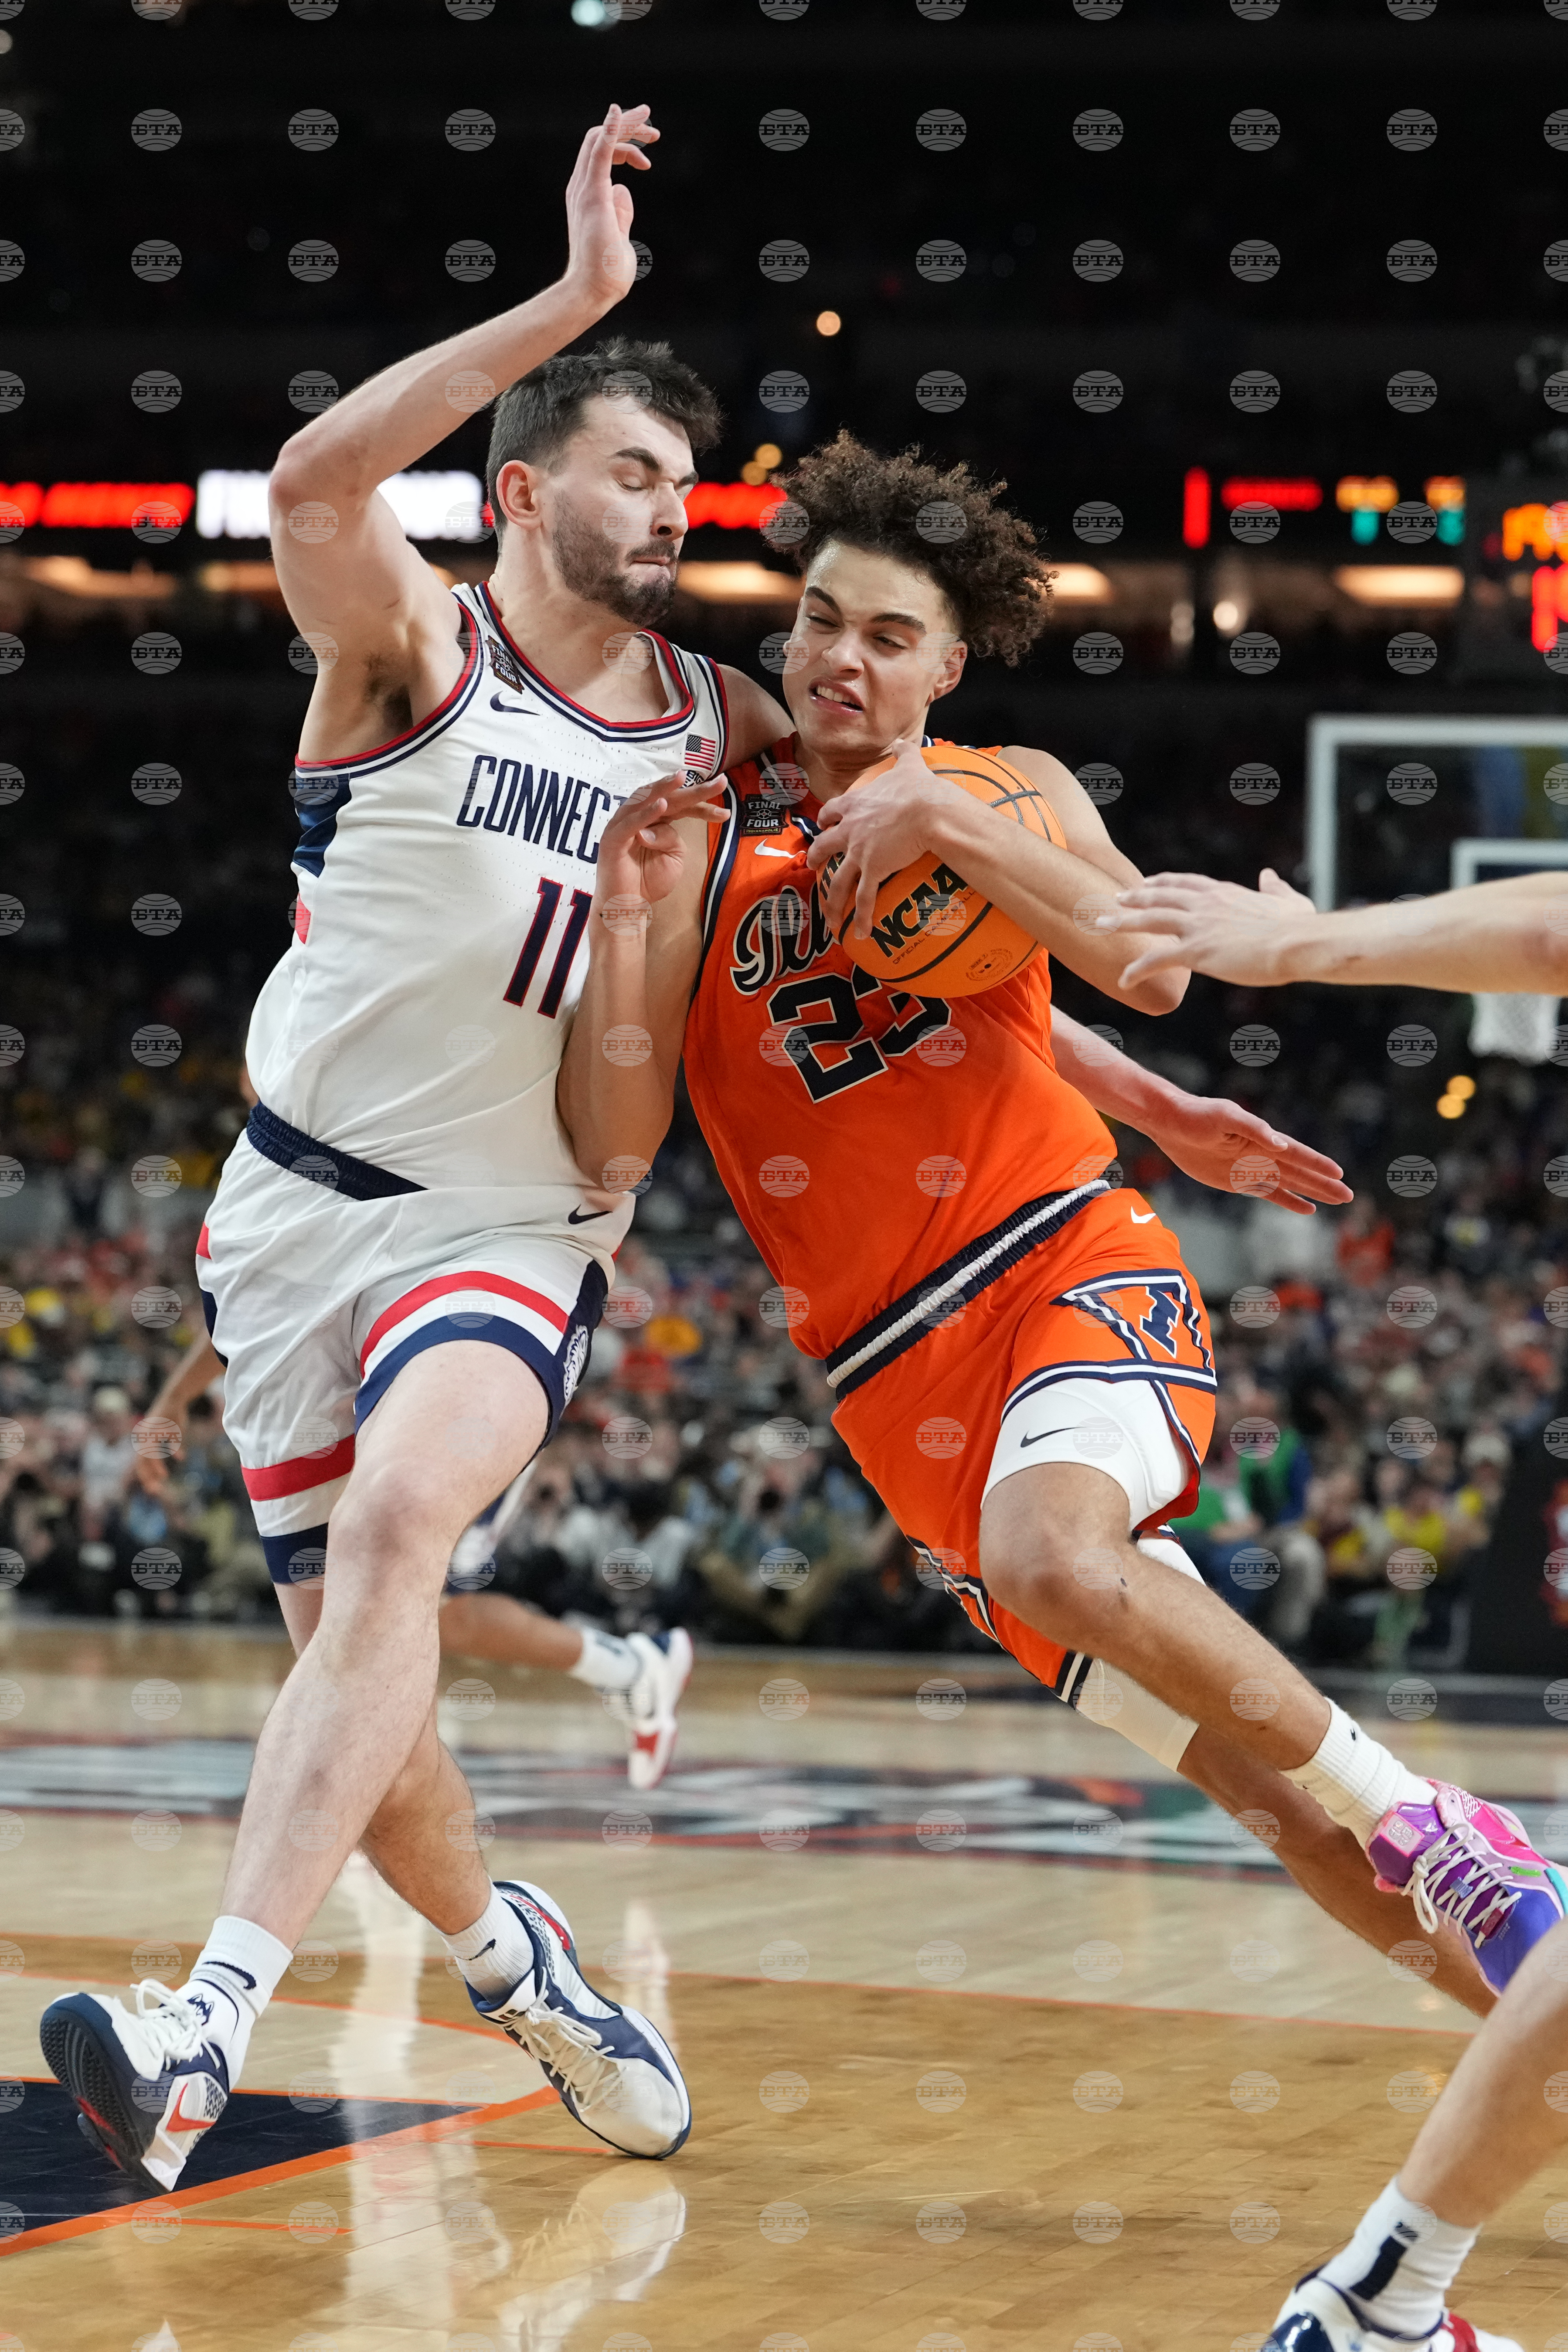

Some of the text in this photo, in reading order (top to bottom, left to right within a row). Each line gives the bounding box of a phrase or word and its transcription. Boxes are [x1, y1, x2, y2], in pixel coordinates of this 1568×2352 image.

[491, 644, 514, 668] FINAL
[496, 662, 518, 684] FOUR
[456, 755, 629, 864] CONNEC
[746, 819, 779, 827] FOUR
[748, 801, 781, 810] FINAL
[870, 862, 969, 959] NCAA
[503, 876, 592, 1018] 11
[892, 938, 925, 965] OFFICIAL
[925, 912, 951, 937] GAME
[766, 963, 952, 1104] 23
